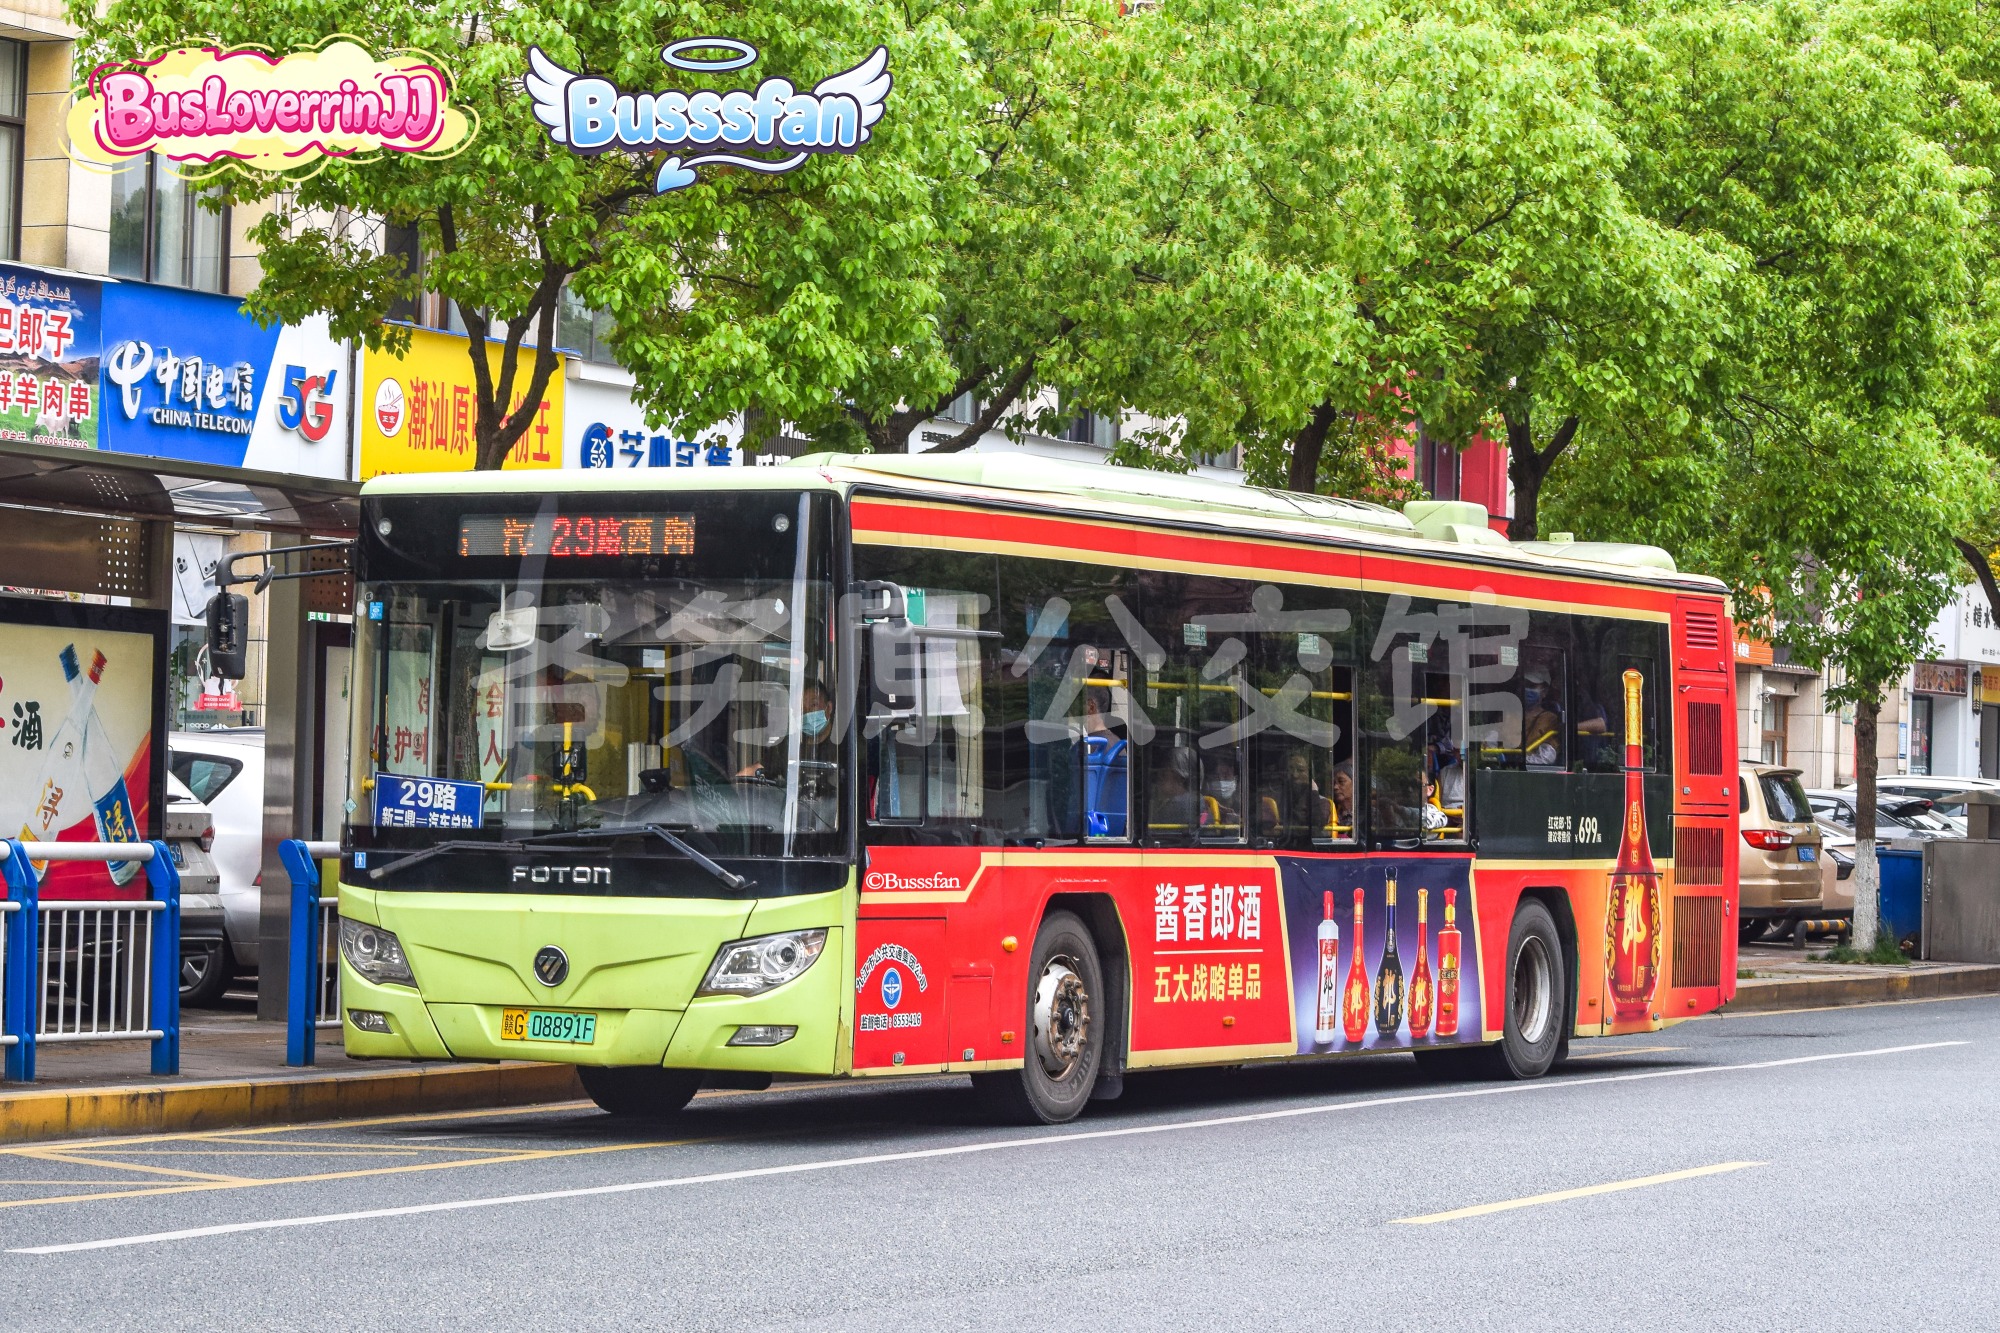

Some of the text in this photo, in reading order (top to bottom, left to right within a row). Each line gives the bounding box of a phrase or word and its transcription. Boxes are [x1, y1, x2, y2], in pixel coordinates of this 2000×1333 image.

[156, 347, 255, 411] 中国电信
[152, 407, 253, 434] CHINA TELECOM
[276, 364, 337, 443] 5G
[12, 701, 43, 751] 酒
[399, 781, 457, 812] 29路
[512, 865, 612, 885] FOTON
[1154, 882, 1262, 942] 酱香郎酒
[856, 943, 928, 993] 九江市公共交通集团公司
[1153, 962, 1261, 1003] 五大战略单品
[531, 1014, 595, 1040] 08891F
